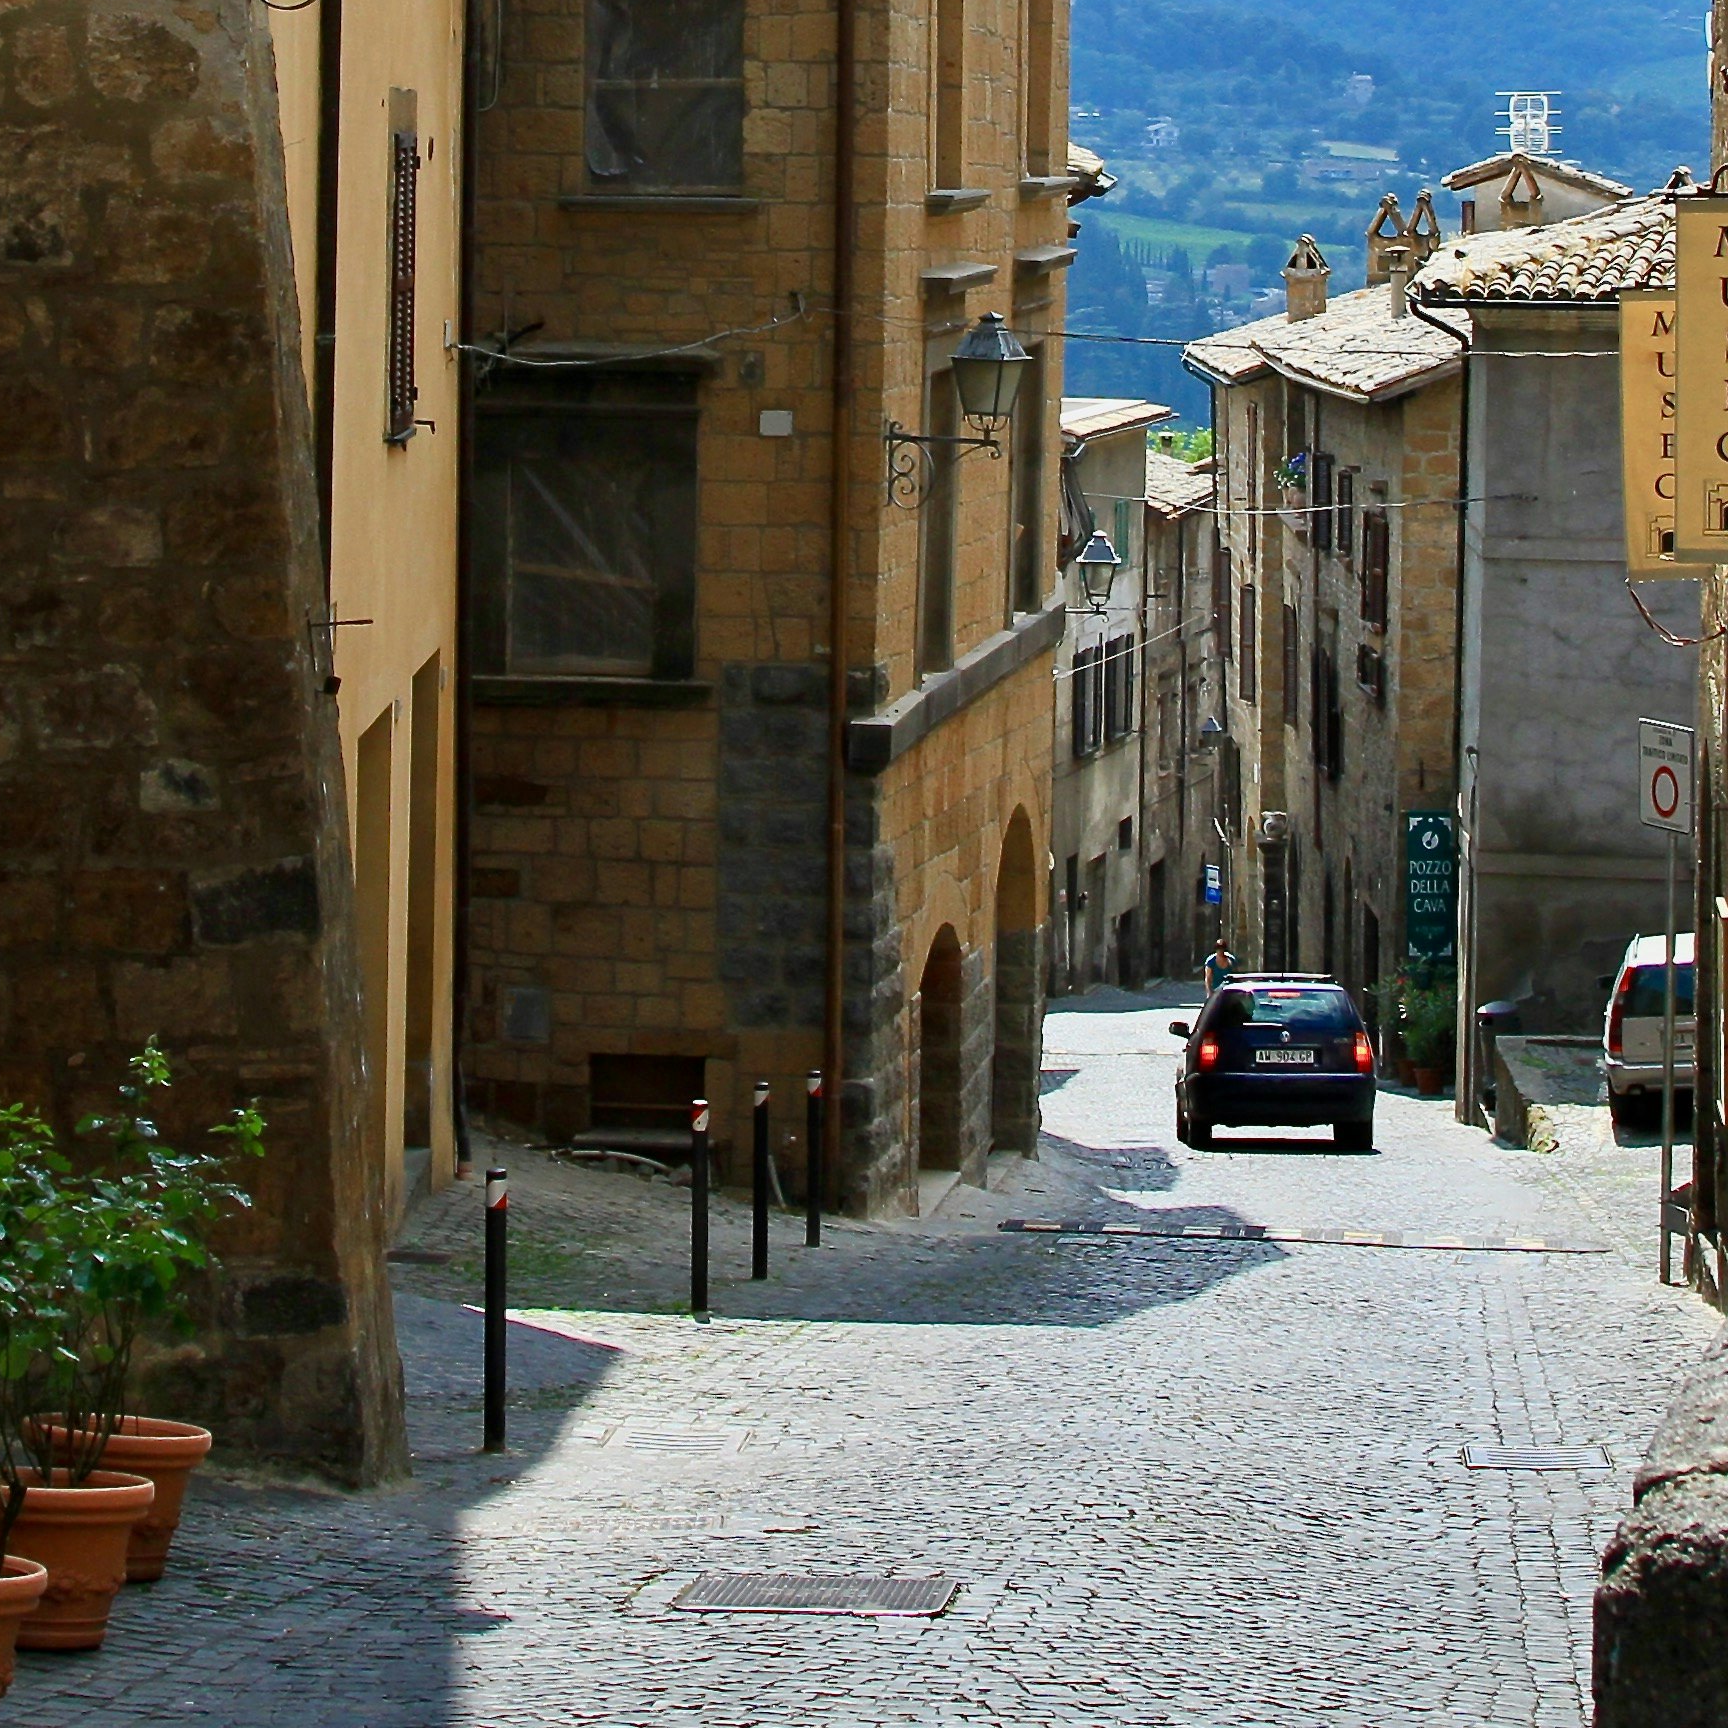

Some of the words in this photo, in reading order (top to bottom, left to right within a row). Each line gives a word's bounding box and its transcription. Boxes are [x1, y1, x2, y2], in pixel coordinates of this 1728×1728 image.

[1409, 860, 1452, 875] POZZO
[1410, 879, 1450, 893] DELLA
[1413, 898, 1446, 912] CAVA
